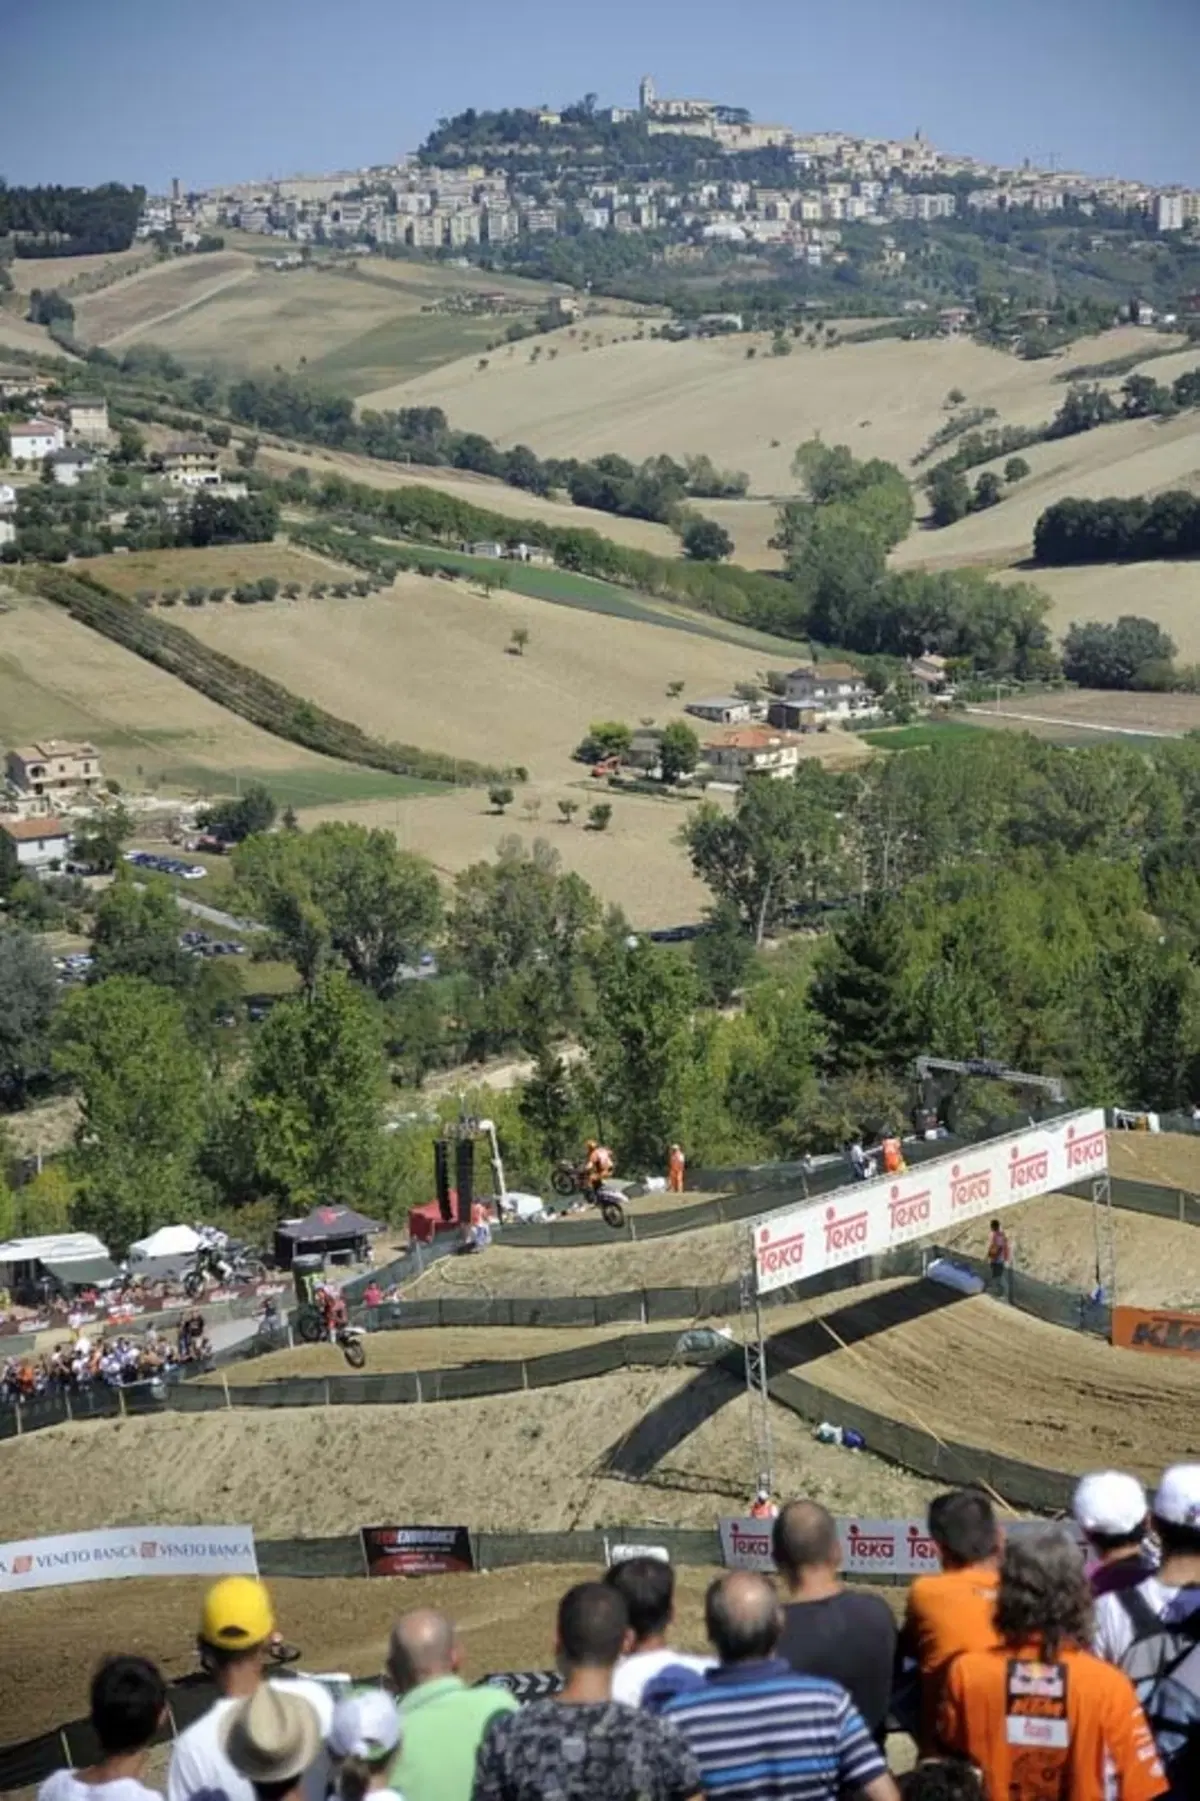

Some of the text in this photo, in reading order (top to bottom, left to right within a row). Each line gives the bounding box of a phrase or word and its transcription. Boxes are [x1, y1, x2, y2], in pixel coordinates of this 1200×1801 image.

[35, 1548, 136, 1568] VENETO BANCA
[159, 1543, 251, 1558] VENETO BANCA
